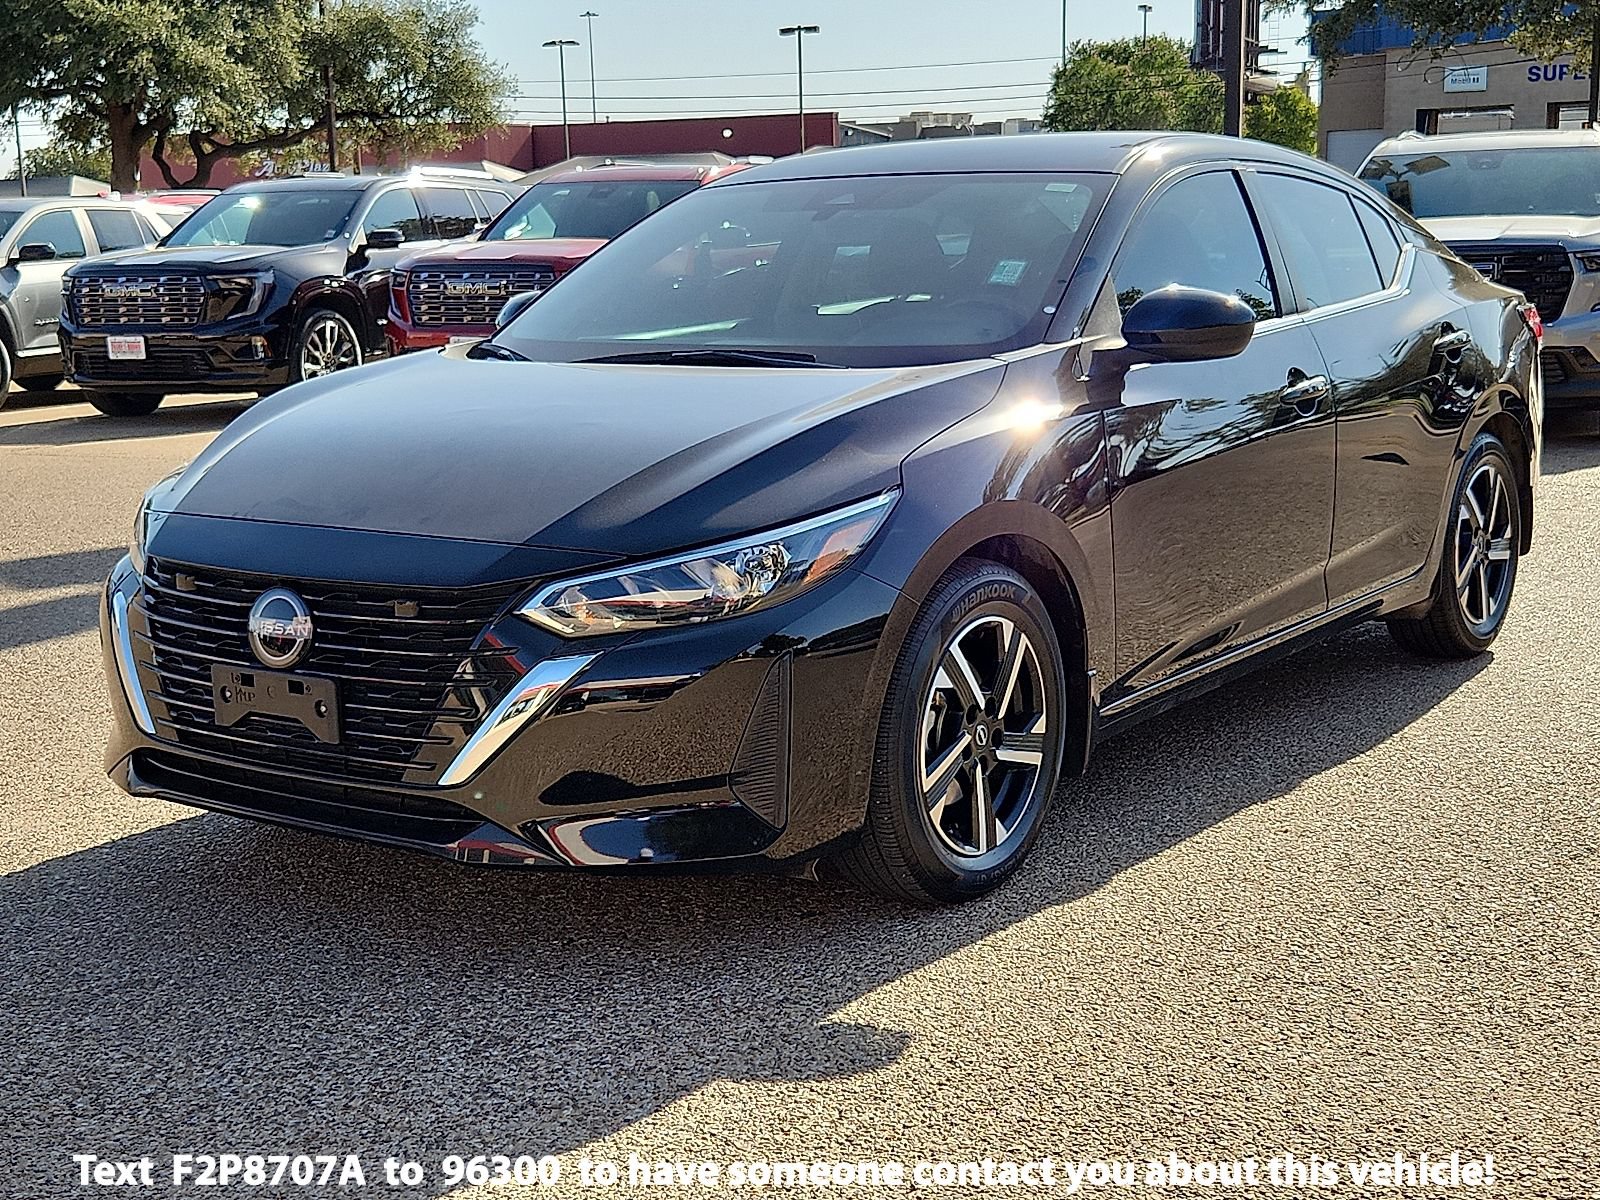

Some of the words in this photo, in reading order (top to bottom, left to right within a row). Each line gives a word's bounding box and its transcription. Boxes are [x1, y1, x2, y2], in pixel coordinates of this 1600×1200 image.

[102, 283, 157, 298] GMC
[444, 280, 507, 297] GMC
[249, 619, 309, 638] NISSAN
